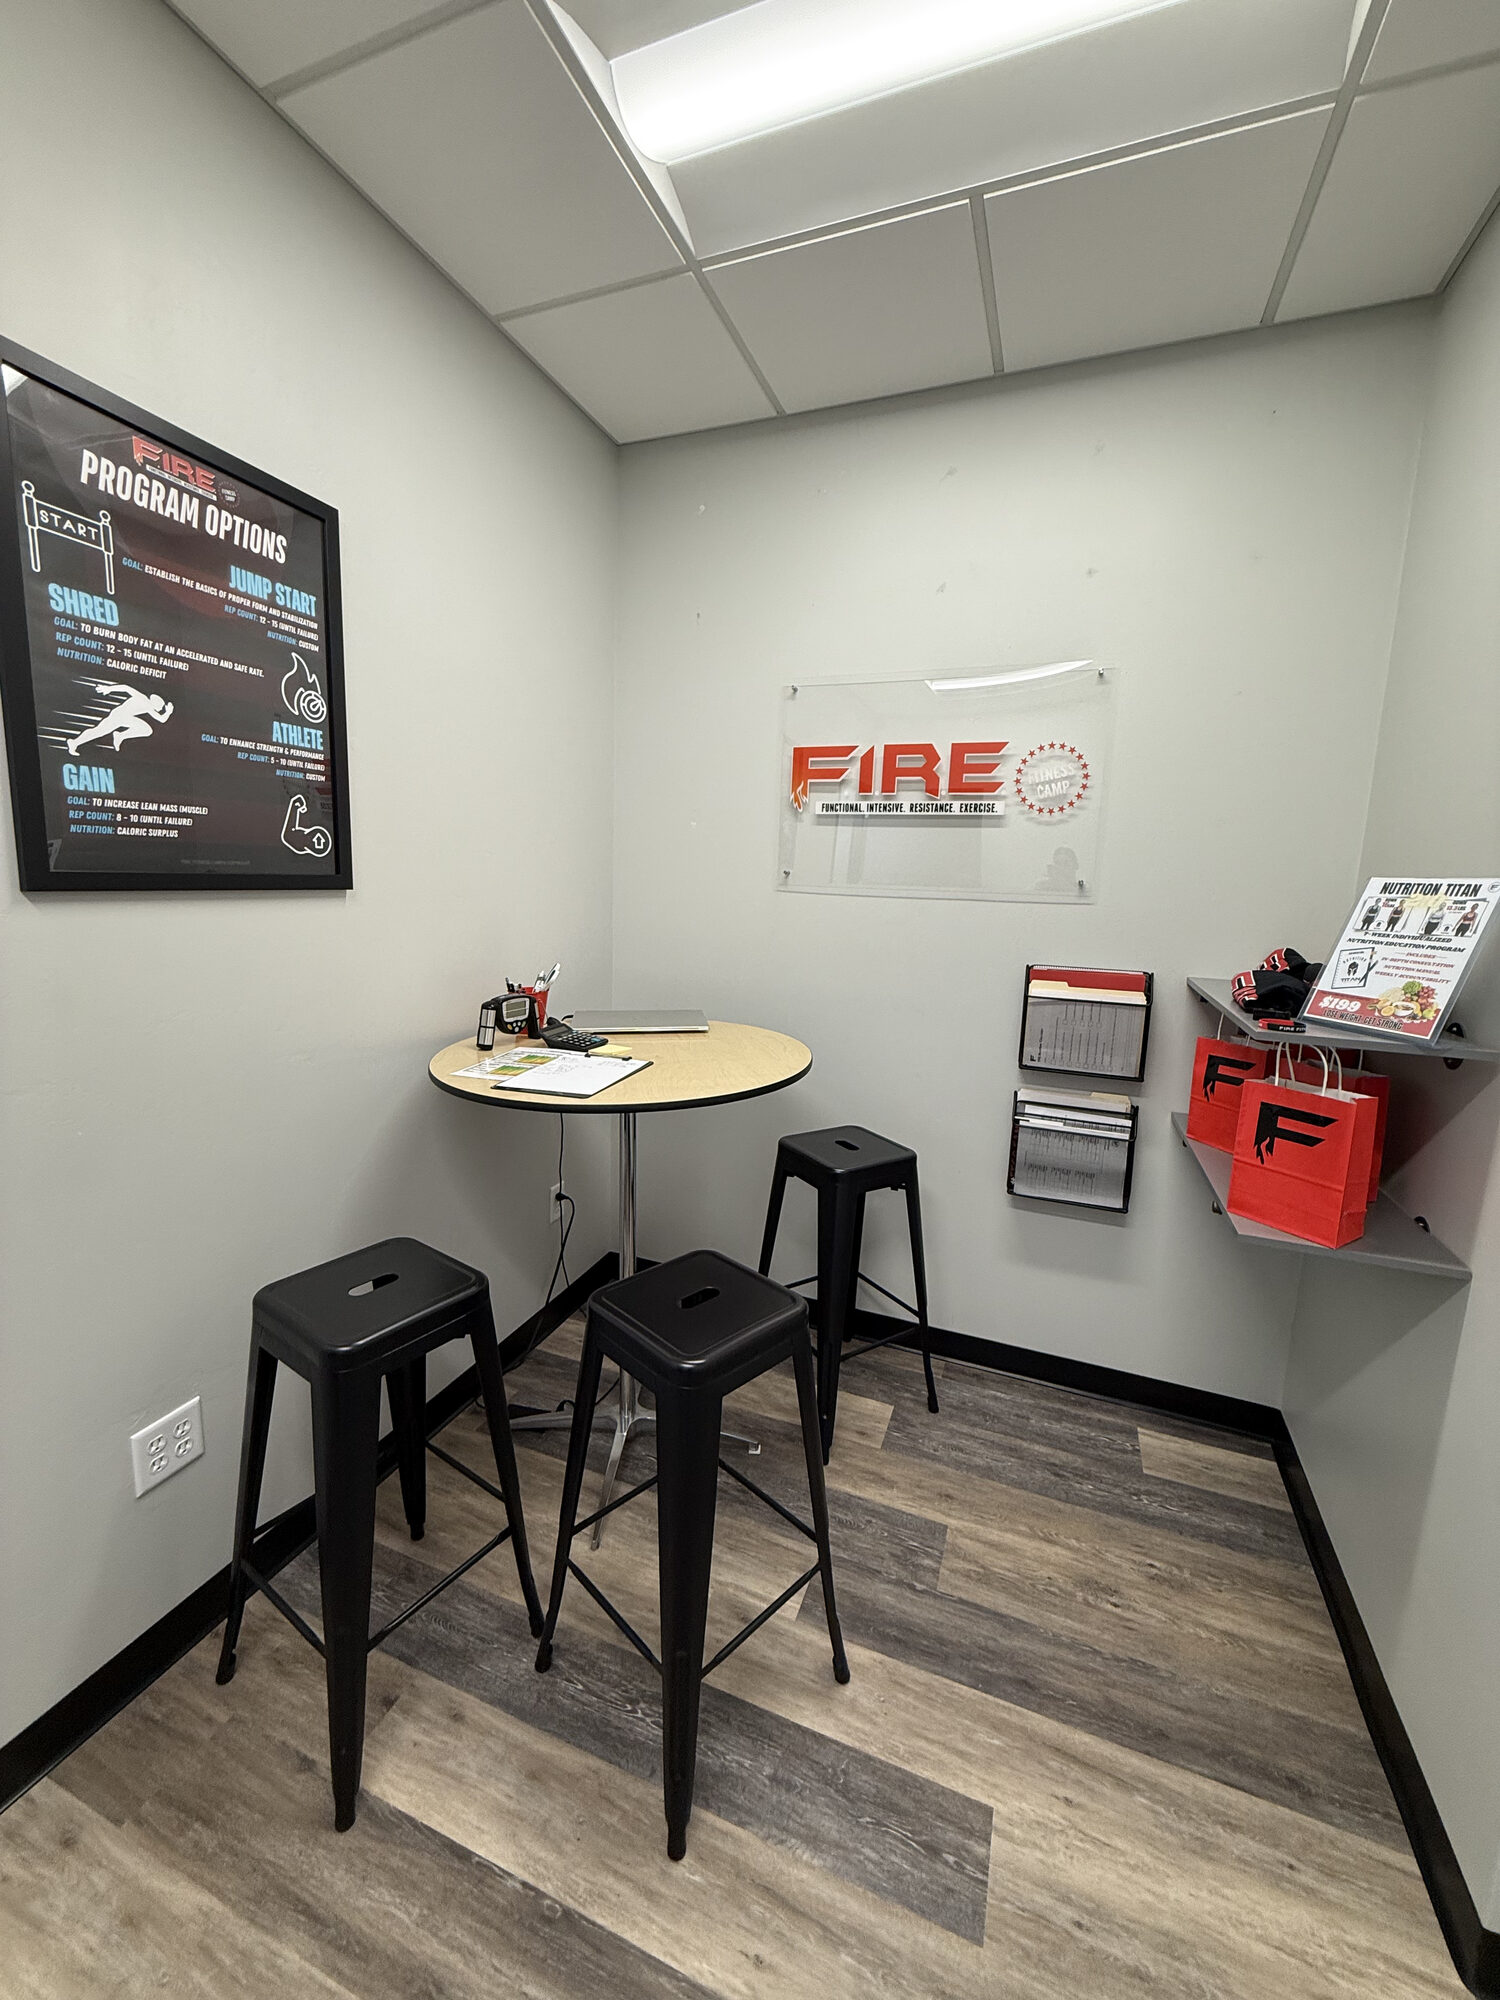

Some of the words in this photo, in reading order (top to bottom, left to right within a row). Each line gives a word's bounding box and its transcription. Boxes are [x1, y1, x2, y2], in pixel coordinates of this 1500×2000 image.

[80, 448, 199, 529] PROGRAM
[205, 504, 288, 564] OPTIONS
[39, 509, 99, 541] START
[122, 557, 143, 571] GOAL:
[144, 565, 181, 583] ESTABLISH
[181, 577, 194, 588] THE
[195, 581, 218, 597] BASICS
[219, 589, 227, 599] OF
[228, 592, 251, 608] PROPER
[251, 600, 268, 613] FORM
[268, 605, 281, 617] AND
[281, 609, 318, 630] STABILIZATION
[229, 565, 273, 600] JUMP
[275, 582, 317, 617] START
[48, 582, 119, 627] SHRED
[224, 604, 236, 615] REP
[237, 608, 258, 622] COUNT:
[259, 615, 266, 624] 12
[271, 619, 278, 629] 15
[54, 616, 78, 631] GOAL:
[81, 622, 91, 634] TO
[93, 625, 116, 640] BURN
[118, 632, 139, 646] BODY
[140, 637, 153, 650] FAT
[154, 641, 163, 651] AT
[165, 644, 175, 655] AN
[176, 647, 219, 666] ACCELERATED
[219, 658, 233, 670] AND
[234, 661, 248, 674] SAFE
[249, 665, 265, 679] RATE.
[267, 630, 298, 646] NUTRITION:
[298, 640, 319, 652] CUSTOM
[55, 632, 72, 643] REP
[74, 636, 104, 651] COUNT:
[106, 643, 116, 654] 12
[123, 647, 132, 658] 15
[133, 650, 158, 664] (UNTIL
[159, 656, 189, 672] FAILURE)
[56, 647, 104, 666] NUTRITION:
[106, 658, 139, 674] CALORIC
[139, 664, 167, 680] DEFICIT
[272, 721, 324, 751] ATHLETE
[201, 733, 219, 743] GOAL:
[220, 736, 228, 745] TO
[229, 738, 256, 750] ENHANCE
[256, 742, 284, 754] STRENGTH
[284, 747, 289, 755] &
[290, 748, 325, 761] PERFORMANCE
[237, 751, 249, 760] REP
[270, 756, 275, 764] 5
[62, 763, 116, 794] GAIN
[305, 773, 326, 783] CUSTOM
[1036, 780, 1070, 799] CAMP
[67, 796, 90, 806] GOAL:
[92, 797, 102, 807] TO
[104, 798, 139, 810] INCREASE
[140, 801, 158, 811] LEAN
[159, 802, 178, 813] MASS
[179, 804, 209, 815] (MUSCLE)
[821, 802, 865, 813] FUNCTIONAL.
[866, 803, 905, 813] INTENSIVE.
[909, 803, 956, 813] RESISTANCE.
[959, 803, 998, 813] EXERCISE.
[68, 810, 85, 819] REP
[86, 811, 114, 821] COUNT:
[116, 813, 122, 822] 8
[129, 814, 139, 823] 10
[139, 814, 163, 825] (UNTIL
[164, 815, 193, 826] FAILURE)
[70, 824, 115, 835] NUTRITION:
[117, 826, 147, 837] CALORIC
[148, 827, 179, 838] SURPLUS
[1379, 882, 1443, 896] NUTRITION
[1443, 883, 1482, 897] TITAN
[1347, 937, 1384, 946] NUTRITION
[1384, 941, 1425, 950] EDUCATION
[1425, 944, 1466, 953] PROGRAM
[1391, 933, 1453, 943] INDIVIDUALIZED
[1384, 964, 1416, 972] NUTRITION
[1409, 959, 1455, 969] CONSULTATION
[1398, 973, 1451, 984] ACCOUNTABILITY
[1318, 995, 1362, 1012] $199
[1323, 1009, 1339, 1018] LOSE
[1364, 1016, 1377, 1025] GET
[1376, 1018, 1404, 1030] STRONG
[1202, 1054, 1256, 1103] F
[1253, 1101, 1339, 1165] F
